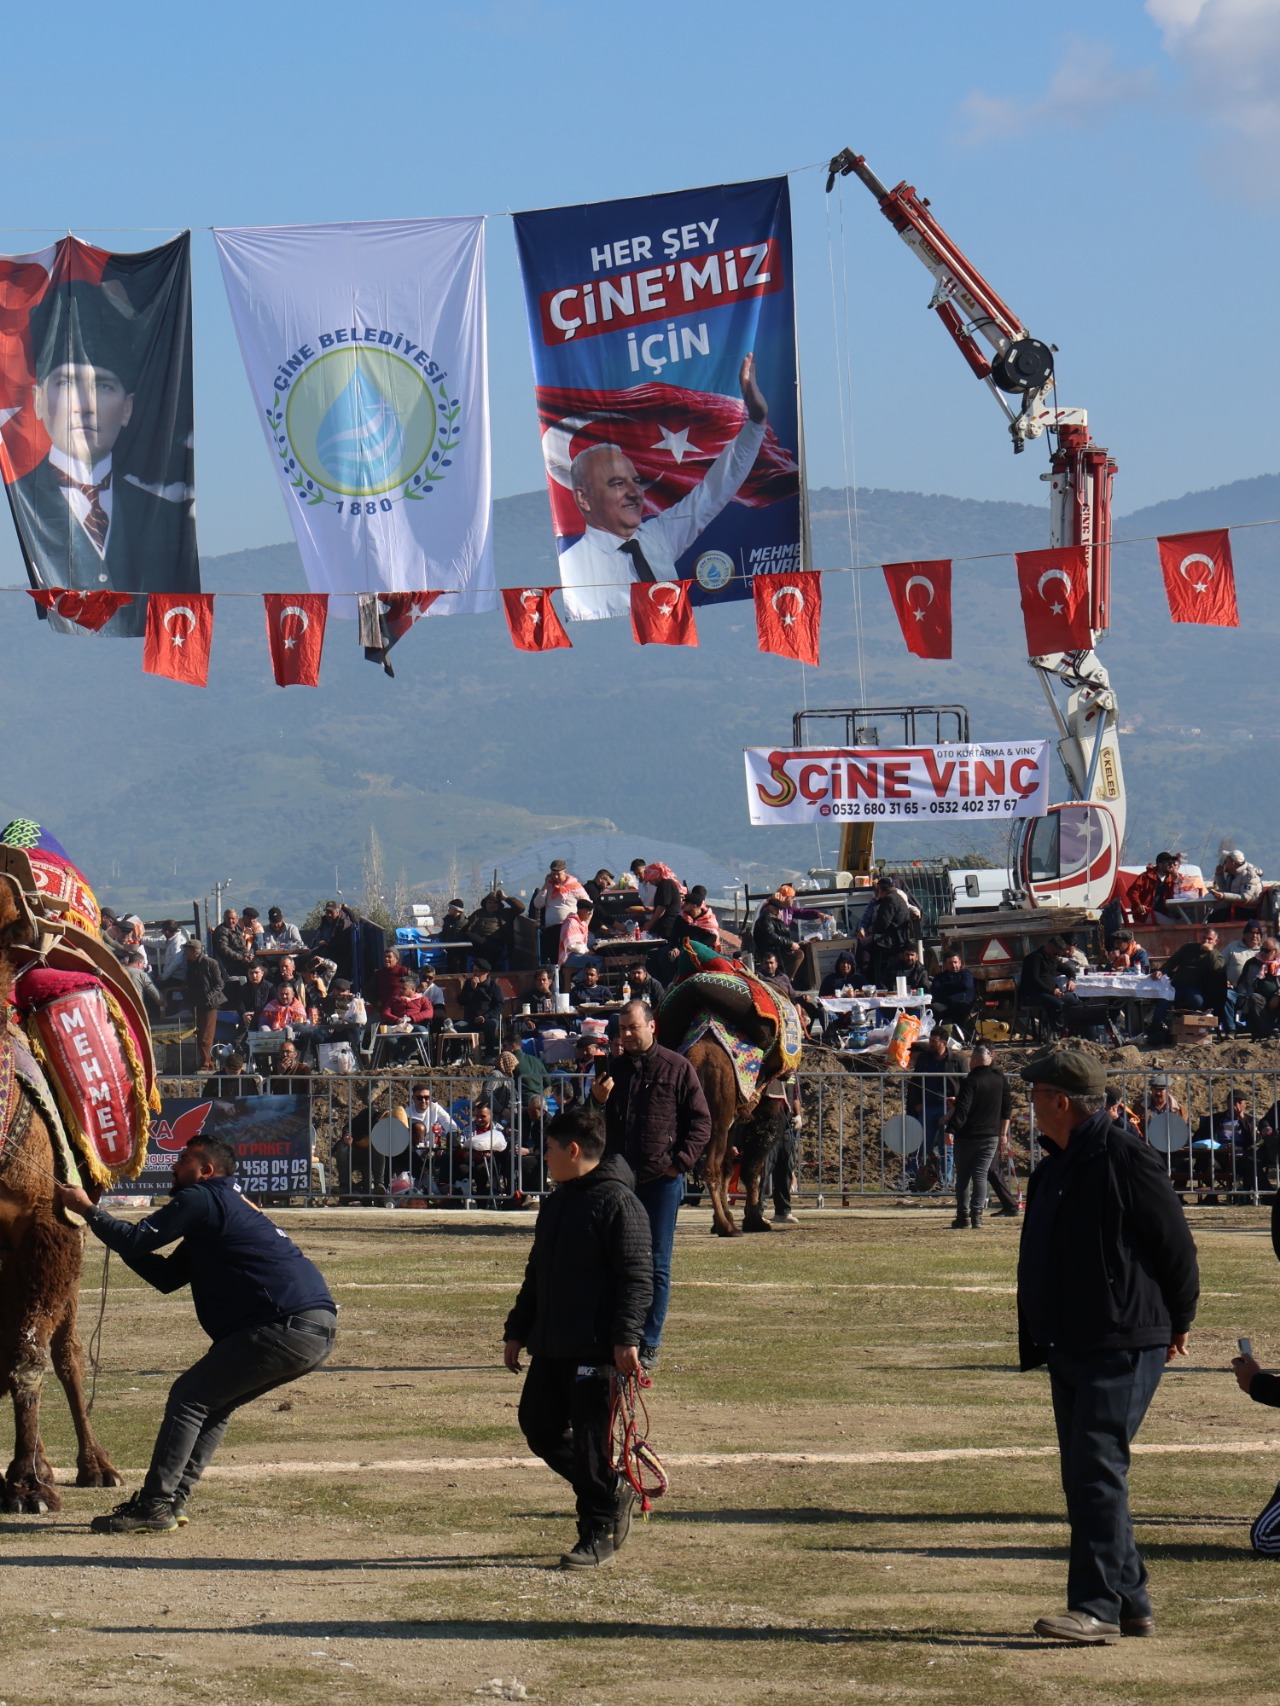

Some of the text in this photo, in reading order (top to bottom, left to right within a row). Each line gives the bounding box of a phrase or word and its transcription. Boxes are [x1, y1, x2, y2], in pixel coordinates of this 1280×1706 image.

[590, 218, 720, 272] HER ŞEY
[626, 323, 710, 375] İÇİN
[273, 327, 448, 392] ÇİNE BELEDİYESİ
[335, 497, 393, 516] 1880
[937, 751, 954, 759] OTO
[956, 747, 1005, 759] KURTARMA
[1007, 748, 1013, 756] &
[1104, 760, 1116, 796] KELES
[832, 803, 860, 815] 0532
[864, 803, 886, 815] 680
[889, 802, 901, 815] 31
[904, 802, 919, 814] 65
[929, 801, 959, 813] 0532
[962, 800, 984, 812] 402
[987, 800, 1001, 812] 37
[1004, 799, 1018, 811] 67
[60, 1006, 119, 1152] MEHMET
[250, 1141, 292, 1157] PAKET
[242, 1160, 269, 1176] 458
[271, 1159, 289, 1175] 04
[291, 1158, 308, 1174] 03
[125, 1182, 136, 1190] VE
[137, 1182, 154, 1190] TEK
[242, 1176, 268, 1192] 725
[271, 1176, 289, 1192] 29
[291, 1174, 309, 1190] 73
